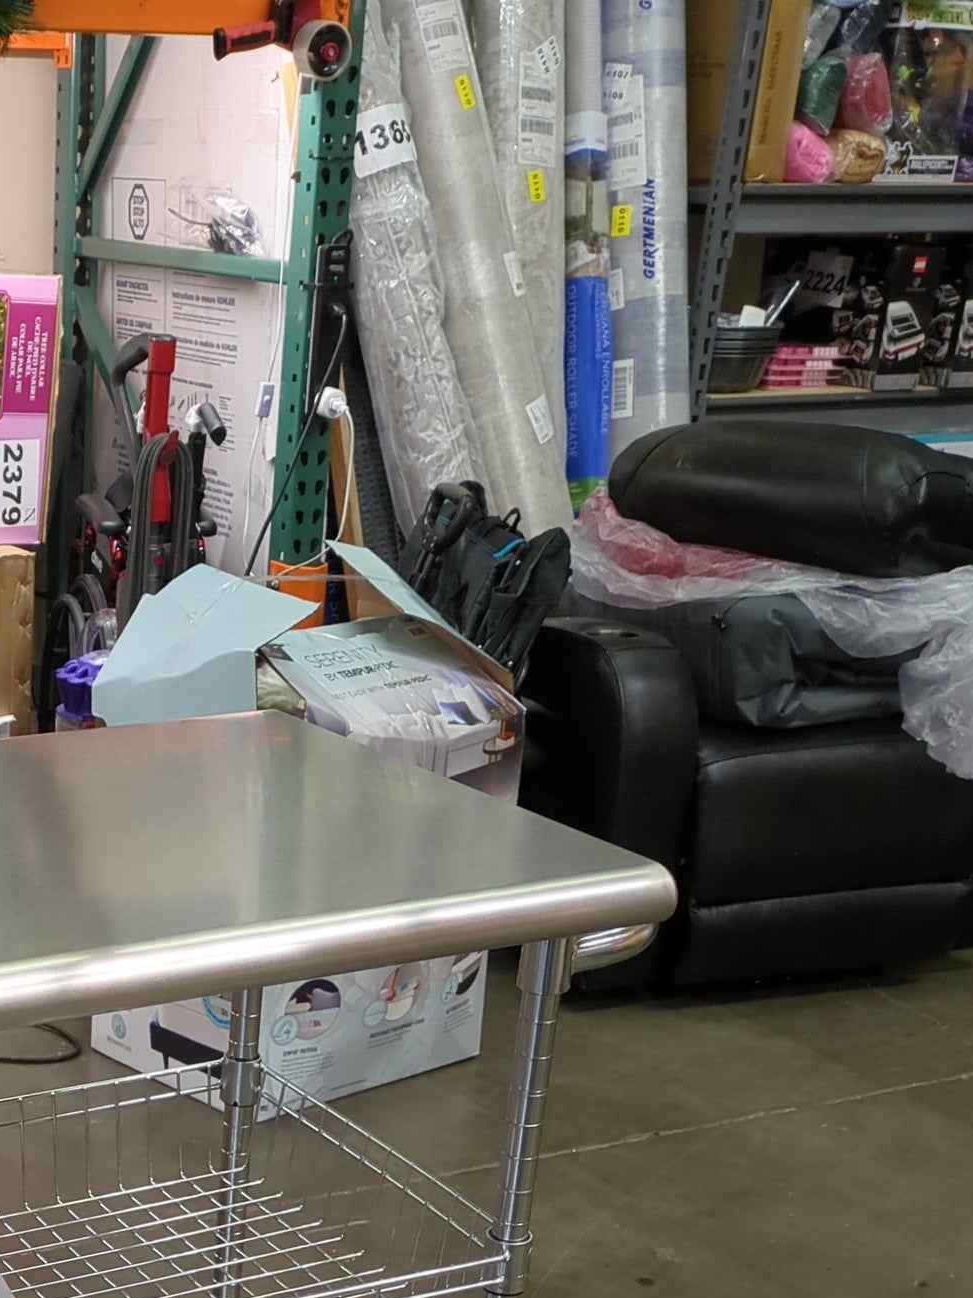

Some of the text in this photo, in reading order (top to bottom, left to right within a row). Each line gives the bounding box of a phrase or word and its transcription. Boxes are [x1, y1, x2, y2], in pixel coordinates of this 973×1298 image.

[133, 195, 145, 204] STOP
[133, 207, 145, 216] STOP
[133, 218, 145, 228] ALTO
[642, 179, 659, 279] GERTMENIAN
[802, 269, 846, 295] 2224
[11, 336, 18, 349] DE
[18, 323, 26, 356] COLLAR
[27, 341, 33, 352] DE
[16, 357, 24, 379] PARA
[38, 354, 46, 387] COLLAR
[567, 284, 577, 458] OUTDOOR ROLLER SHADE
[1, 443, 24, 526] 2379
[304, 644, 382, 668] SERENITY
